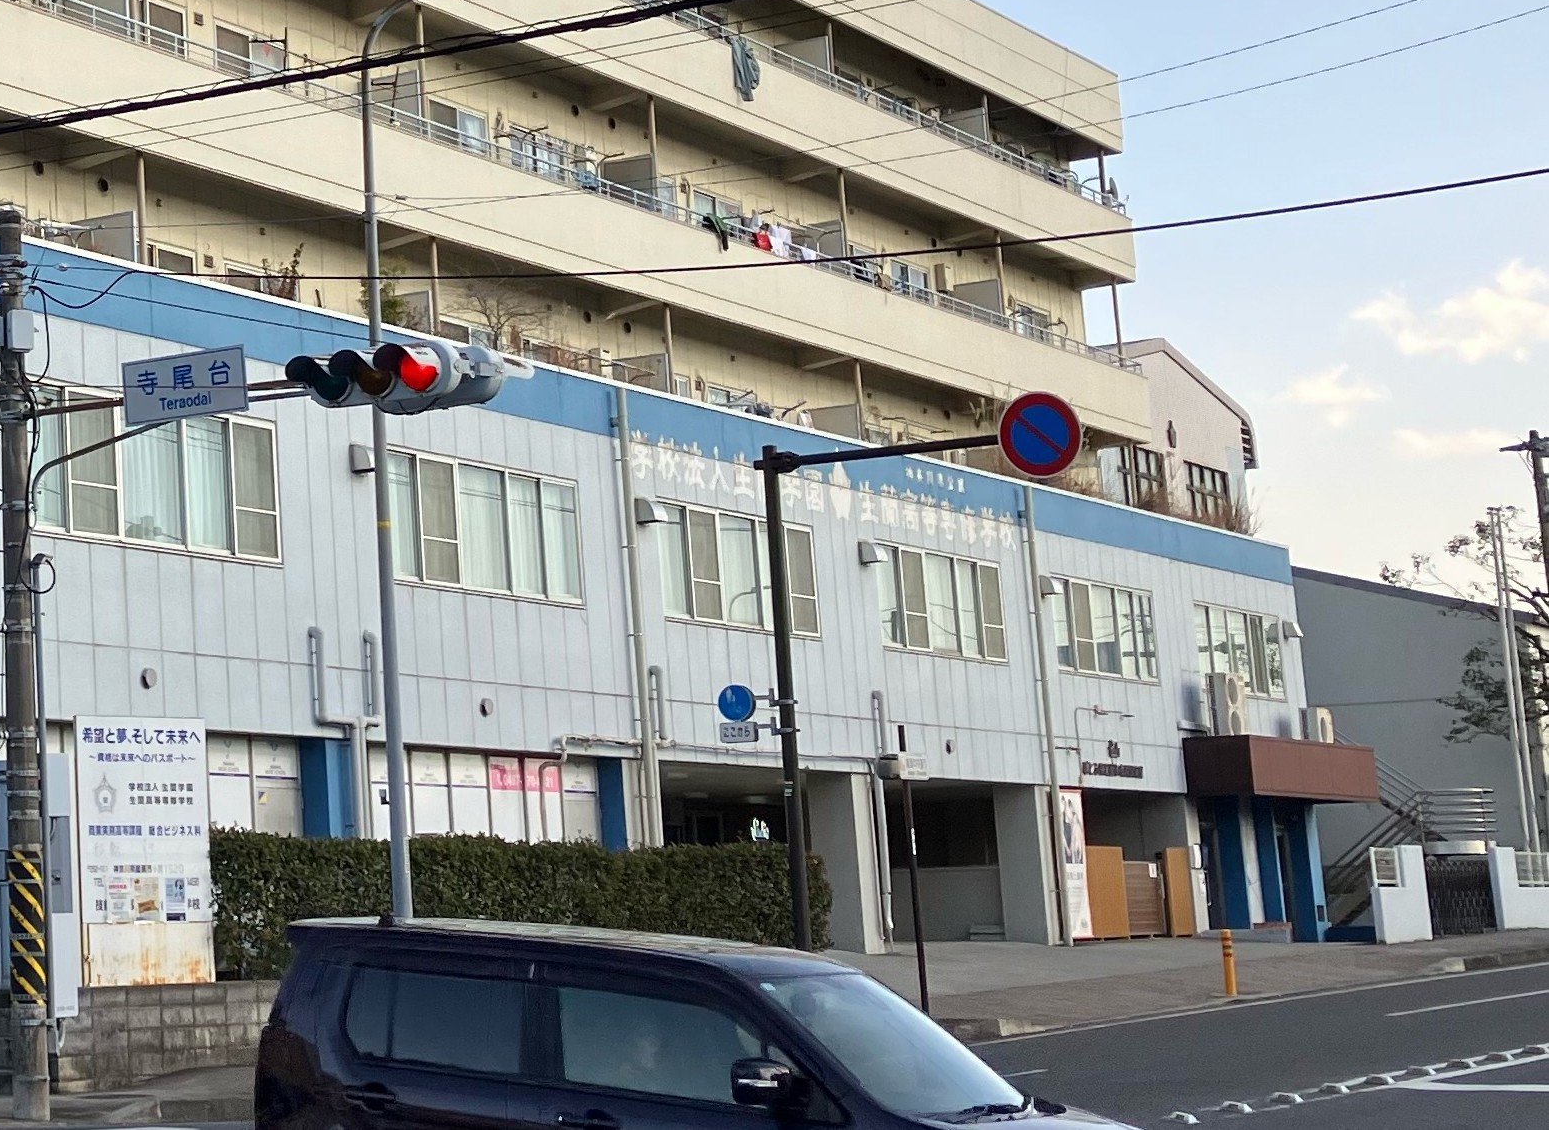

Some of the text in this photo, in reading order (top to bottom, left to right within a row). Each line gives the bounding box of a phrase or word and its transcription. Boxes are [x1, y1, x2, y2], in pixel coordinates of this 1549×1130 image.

[137, 360, 231, 395] 寺尾台
[159, 391, 212, 412] Teraodai
[631, 429, 825, 513] 学校法人生学園
[82, 727, 201, 745] 希望と夢、そして未来へ
